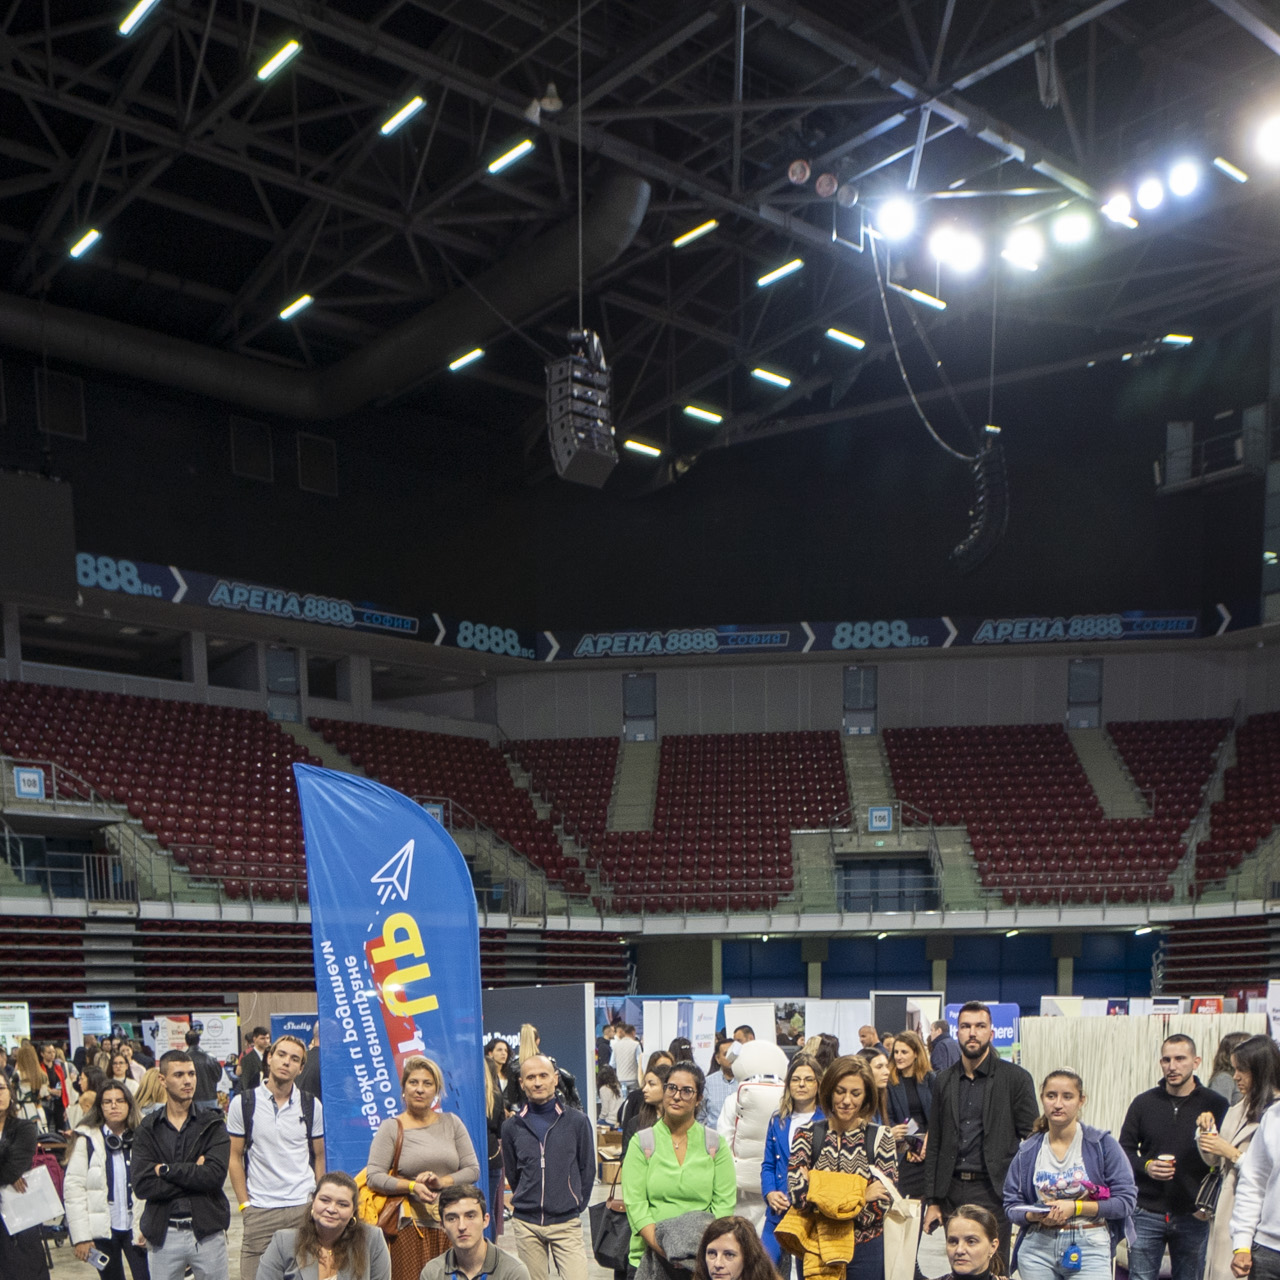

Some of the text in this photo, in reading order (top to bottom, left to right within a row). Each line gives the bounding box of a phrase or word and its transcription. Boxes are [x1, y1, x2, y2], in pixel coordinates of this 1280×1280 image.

[210, 583, 301, 616] АРЕНА
[303, 599, 355, 625] 8888
[979, 619, 1064, 641] АРЕНА
[1068, 615, 1123, 638] 8888
[578, 633, 662, 655] АРЕНА
[664, 630, 720, 652] 8888
[283, 1021, 312, 1032] Shelly
